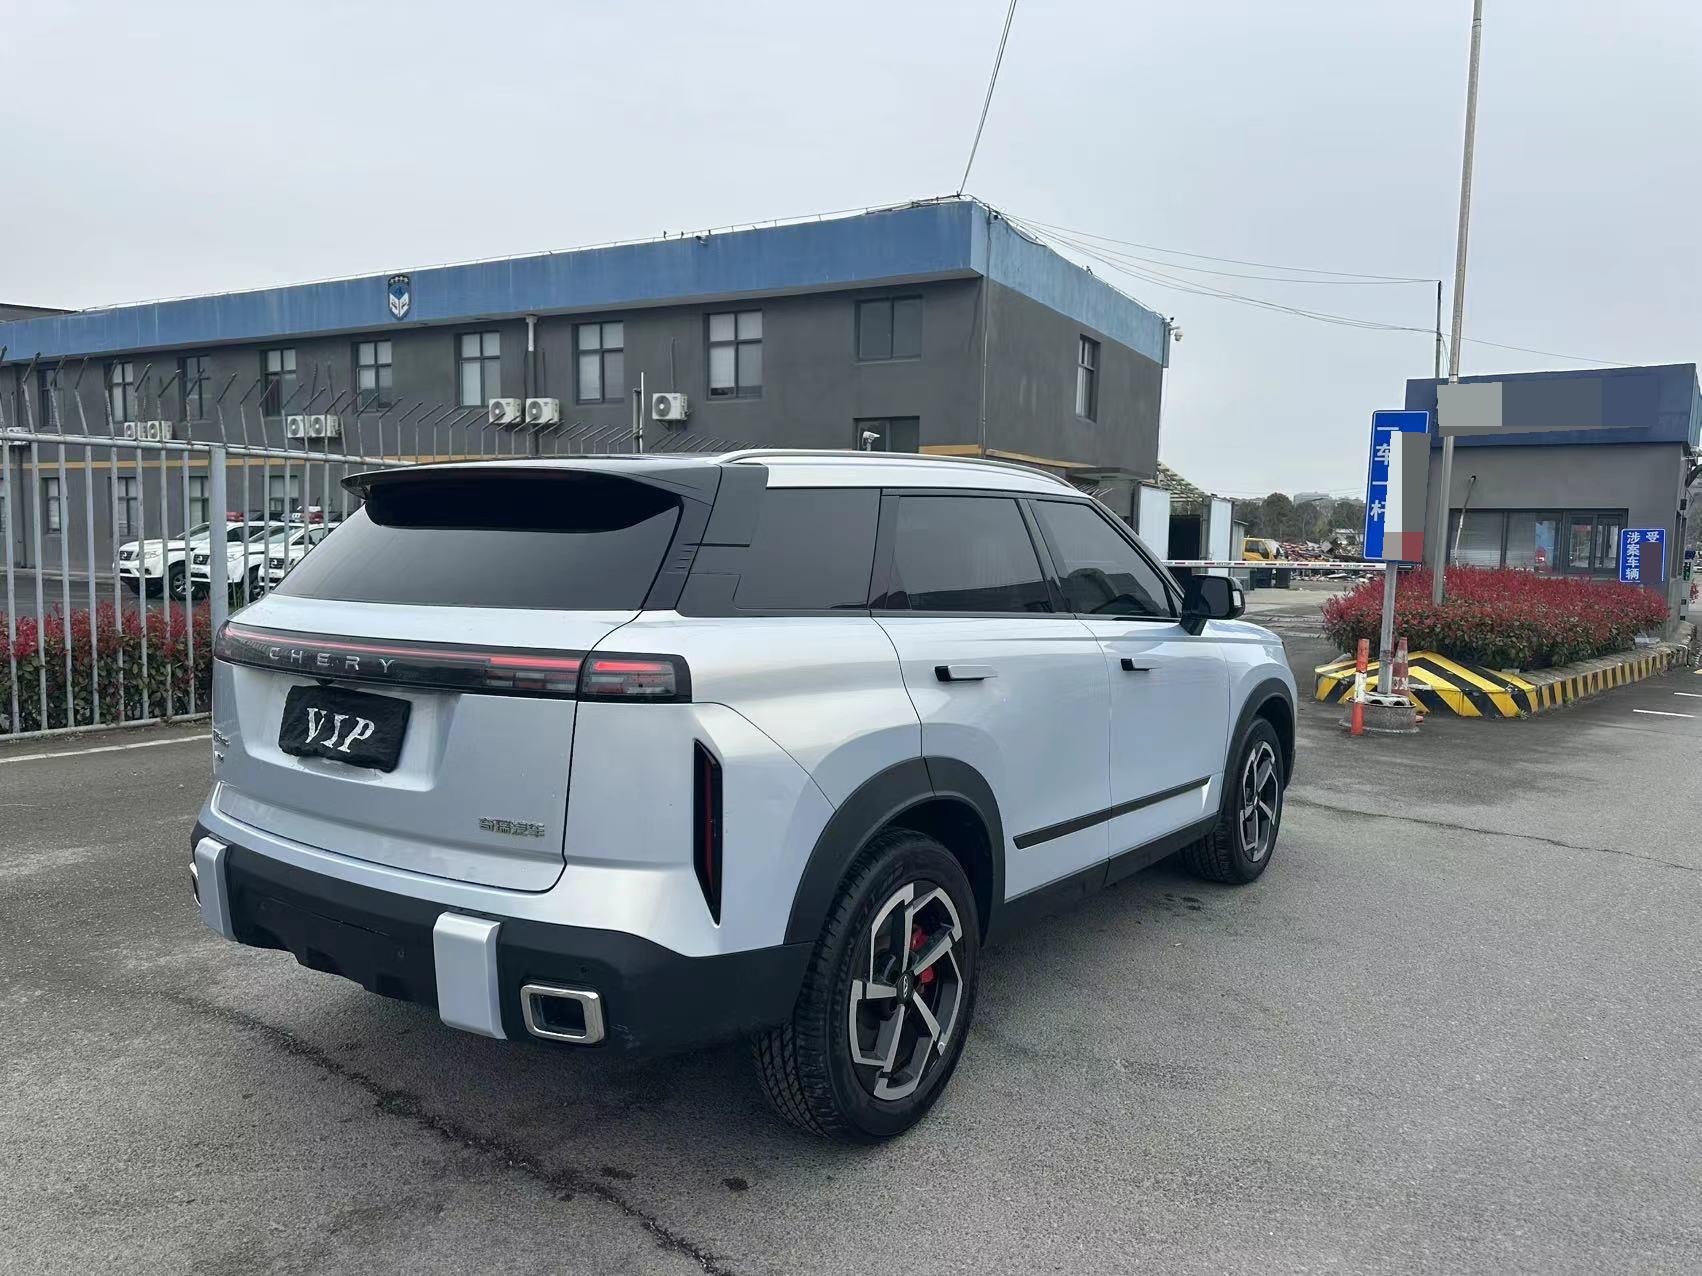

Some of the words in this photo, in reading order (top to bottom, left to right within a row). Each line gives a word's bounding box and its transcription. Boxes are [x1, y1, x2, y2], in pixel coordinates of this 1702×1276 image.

[1626, 532, 1640, 580] 涉案车辆
[268, 647, 395, 673] CHERY
[305, 707, 375, 753] VIP
[479, 817, 545, 837] 奇瑞汽车
